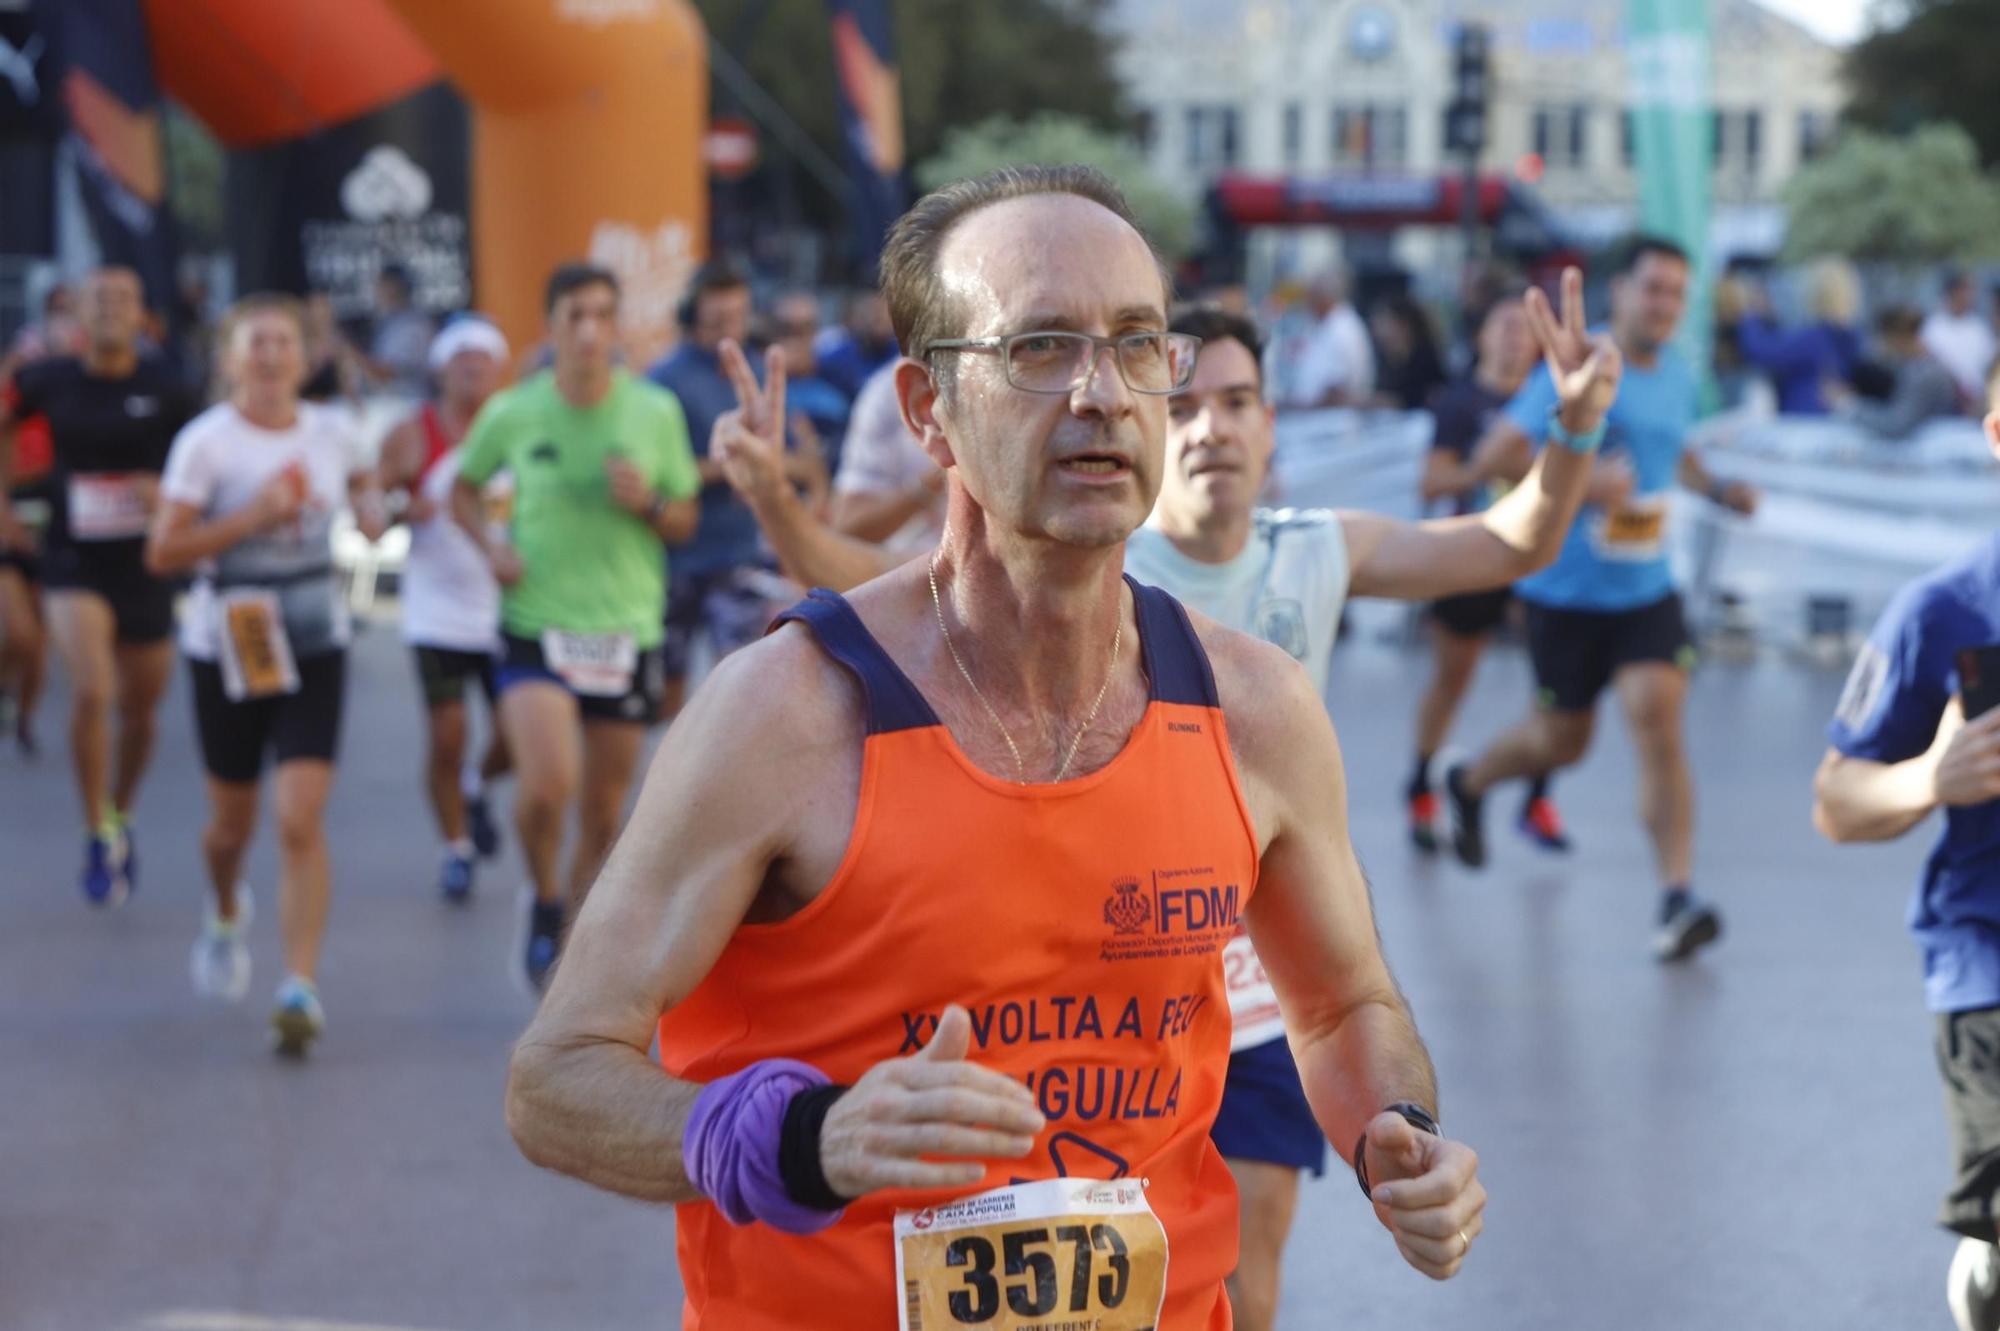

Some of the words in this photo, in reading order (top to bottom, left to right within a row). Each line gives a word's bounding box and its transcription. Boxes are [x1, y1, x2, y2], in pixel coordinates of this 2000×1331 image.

[1160, 885, 1239, 933] FDML
[969, 997, 1104, 1048] VOLTA
[1113, 996, 1143, 1039] A
[945, 1223, 1130, 1324] 3573
